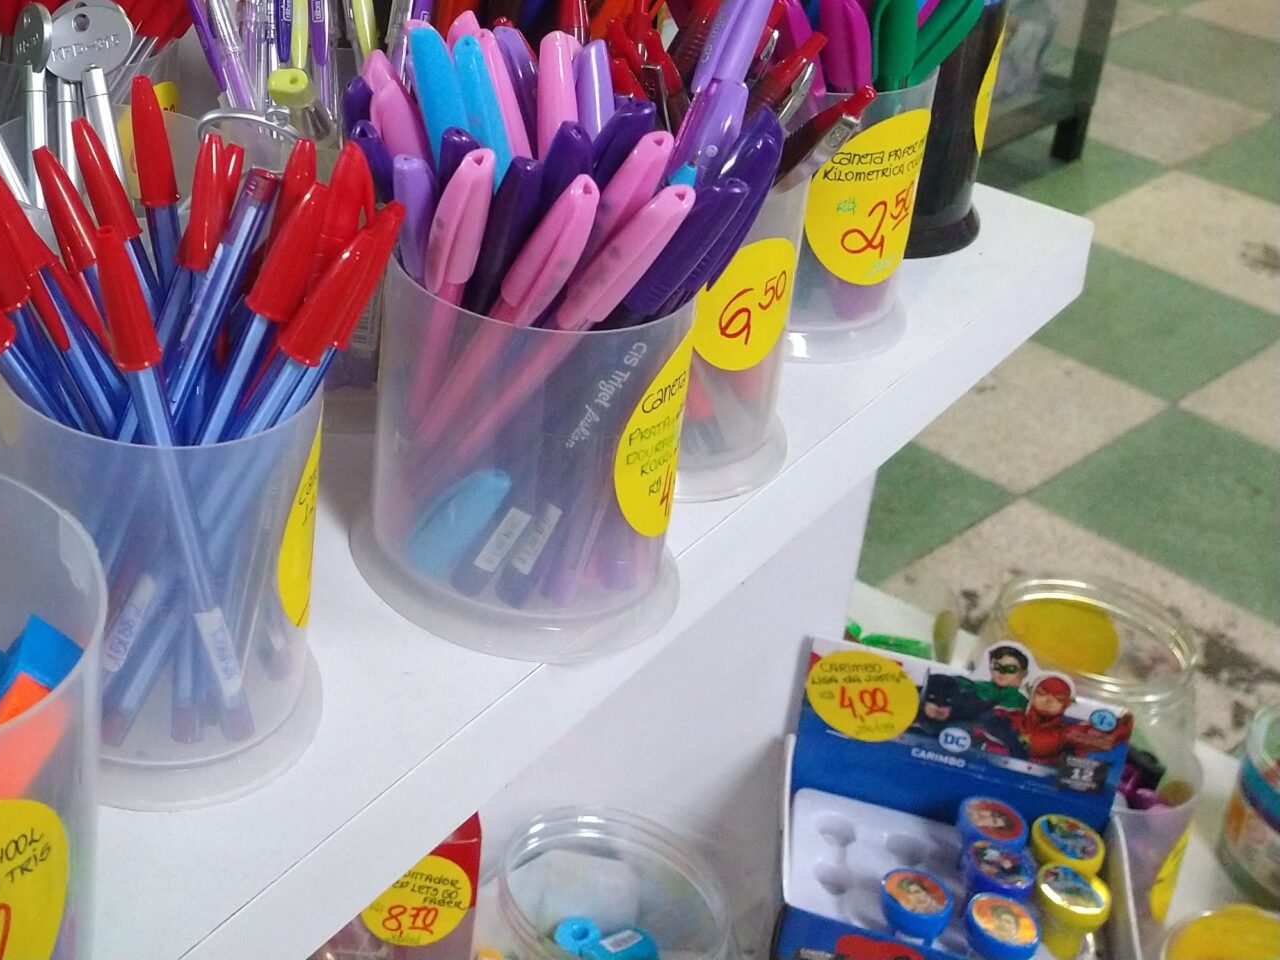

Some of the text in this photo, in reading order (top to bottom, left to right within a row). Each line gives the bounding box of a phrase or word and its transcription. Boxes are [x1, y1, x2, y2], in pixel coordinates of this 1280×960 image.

[624, 342, 648, 367] CIS
[596, 370, 631, 408] Triget
[944, 733, 967, 749] DC
[910, 747, 966, 768] CARIMBO
[1070, 767, 1095, 782] 12
